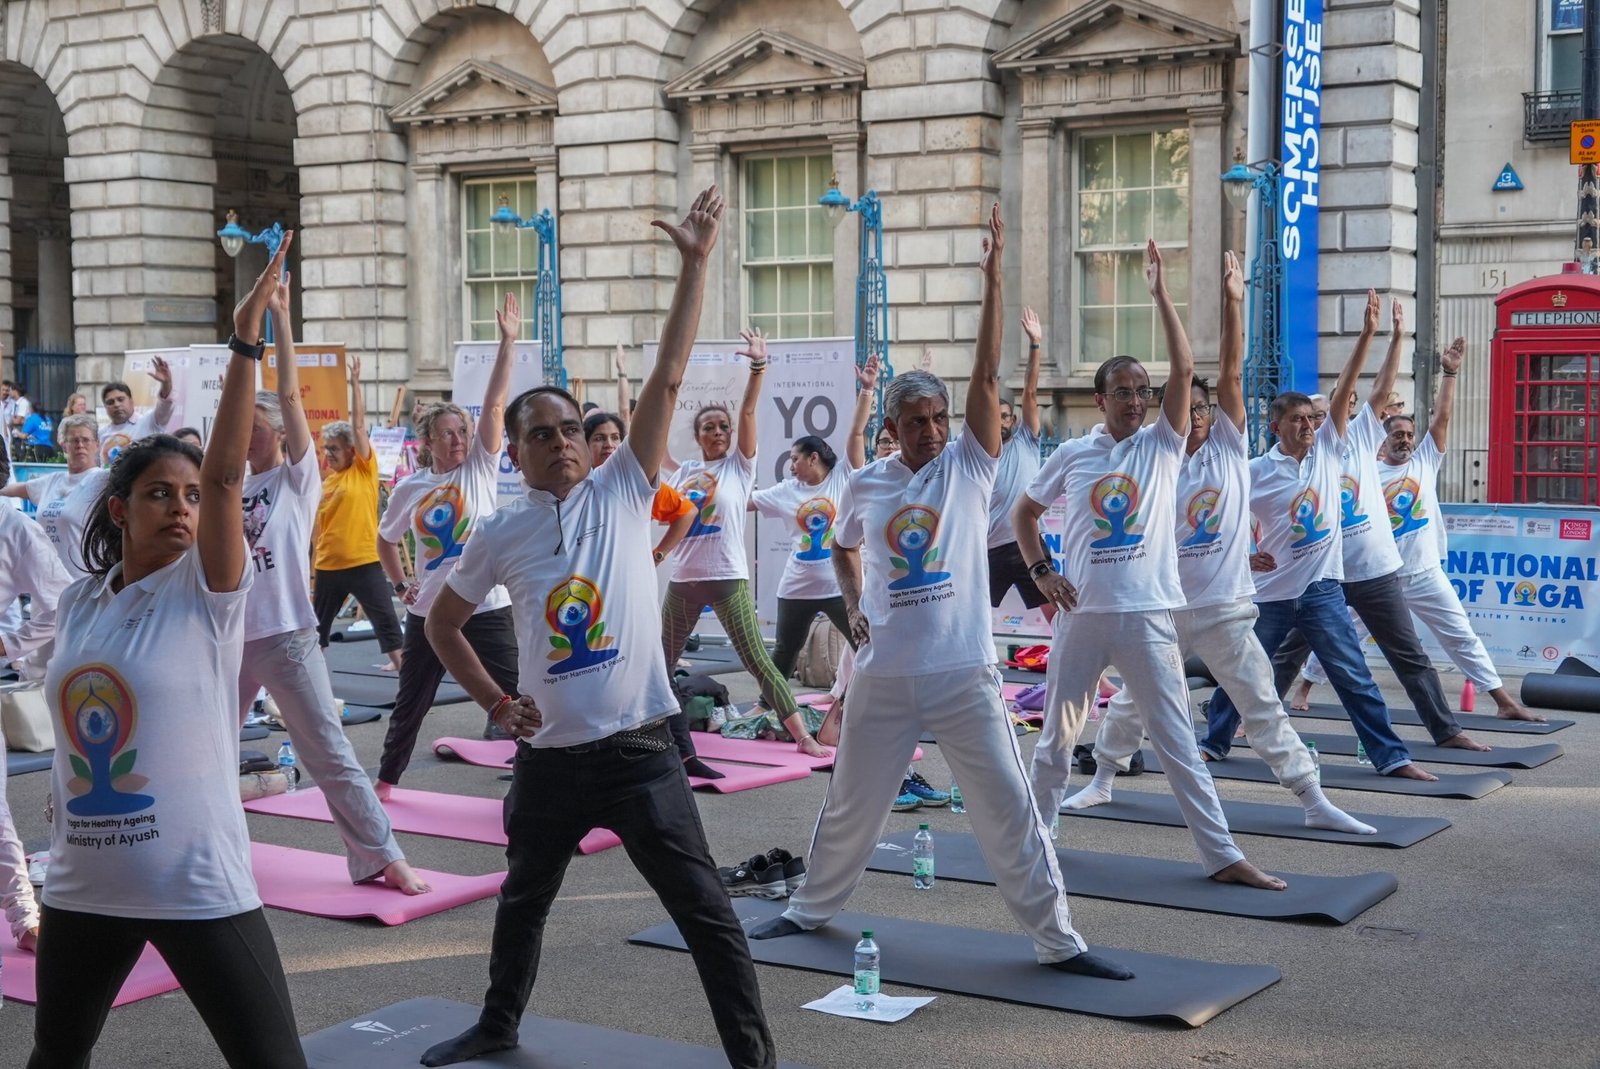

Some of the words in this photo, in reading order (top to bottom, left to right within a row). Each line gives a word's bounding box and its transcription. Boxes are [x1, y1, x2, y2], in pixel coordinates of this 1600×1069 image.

[1481, 269, 1507, 290] 151
[675, 400, 703, 411] OGA
[772, 395, 838, 439] YO
[42, 510, 62, 519] CALM
[46, 526, 57, 534] DO
[252, 551, 275, 573] TE
[1090, 557, 1118, 565] Ministry
[1127, 551, 1147, 561] Ayush
[1442, 550, 1599, 581] NATIONAL
[910, 586, 933, 595] Healthy
[933, 582, 953, 591] Ageing
[1496, 581, 1584, 609] YOGA
[890, 598, 919, 609] Ministry
[920, 595, 929, 604] of
[931, 590, 955, 602] Ayush
[1467, 612, 1510, 620] EALTHY
[1520, 615, 1566, 624] AGEING
[543, 676, 558, 685] Yoga
[559, 673, 569, 682] for
[570, 666, 601, 678] Harmony
[602, 662, 607, 670] &
[608, 655, 626, 667] Peace
[67, 819, 81, 830] Yoga
[81, 819, 91, 828] for
[91, 818, 122, 829] Healthy
[123, 814, 156, 827] Ageing
[66, 833, 102, 850] Ministry
[104, 834, 116, 846] of
[119, 828, 160, 847] Ayush
